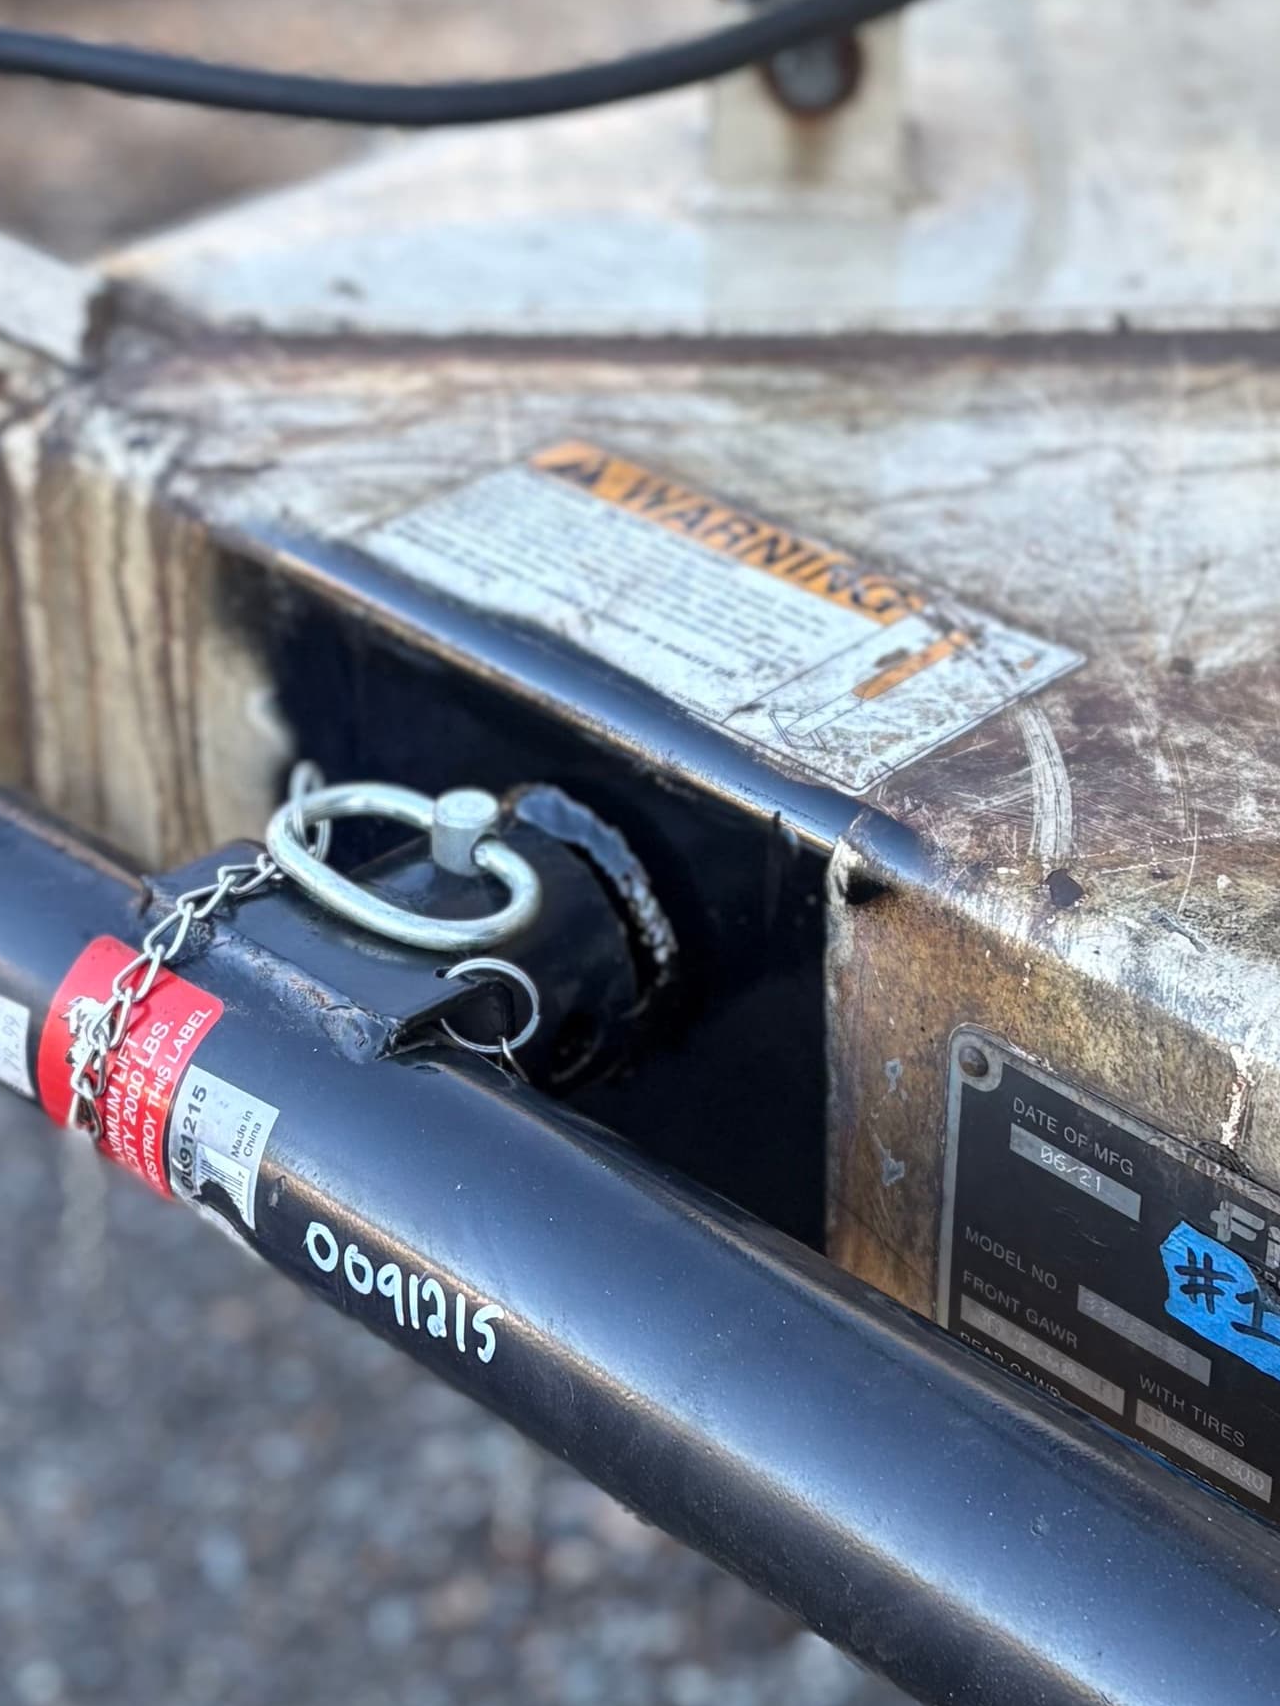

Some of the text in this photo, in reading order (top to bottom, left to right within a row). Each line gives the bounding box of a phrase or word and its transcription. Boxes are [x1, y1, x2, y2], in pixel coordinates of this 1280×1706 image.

[622, 471, 904, 613] WARNING
[112, 1032, 138, 1084] LIFT
[123, 1070, 145, 1127] 2000
[142, 1019, 174, 1070] LBS.
[146, 1063, 171, 1109] THIS
[165, 1008, 213, 1064] LABEL
[230, 1125, 248, 1159] Made
[243, 1122, 262, 1158] China
[1013, 1097, 1134, 1178] DATE OF MFG
[965, 1226, 1026, 1274] MODEL
[307, 1221, 505, 1363] 0091215
[962, 1269, 1021, 1314] FRONT
[1025, 1308, 1079, 1350] GAWR
[1138, 1373, 1246, 1448] WITH TIRES
